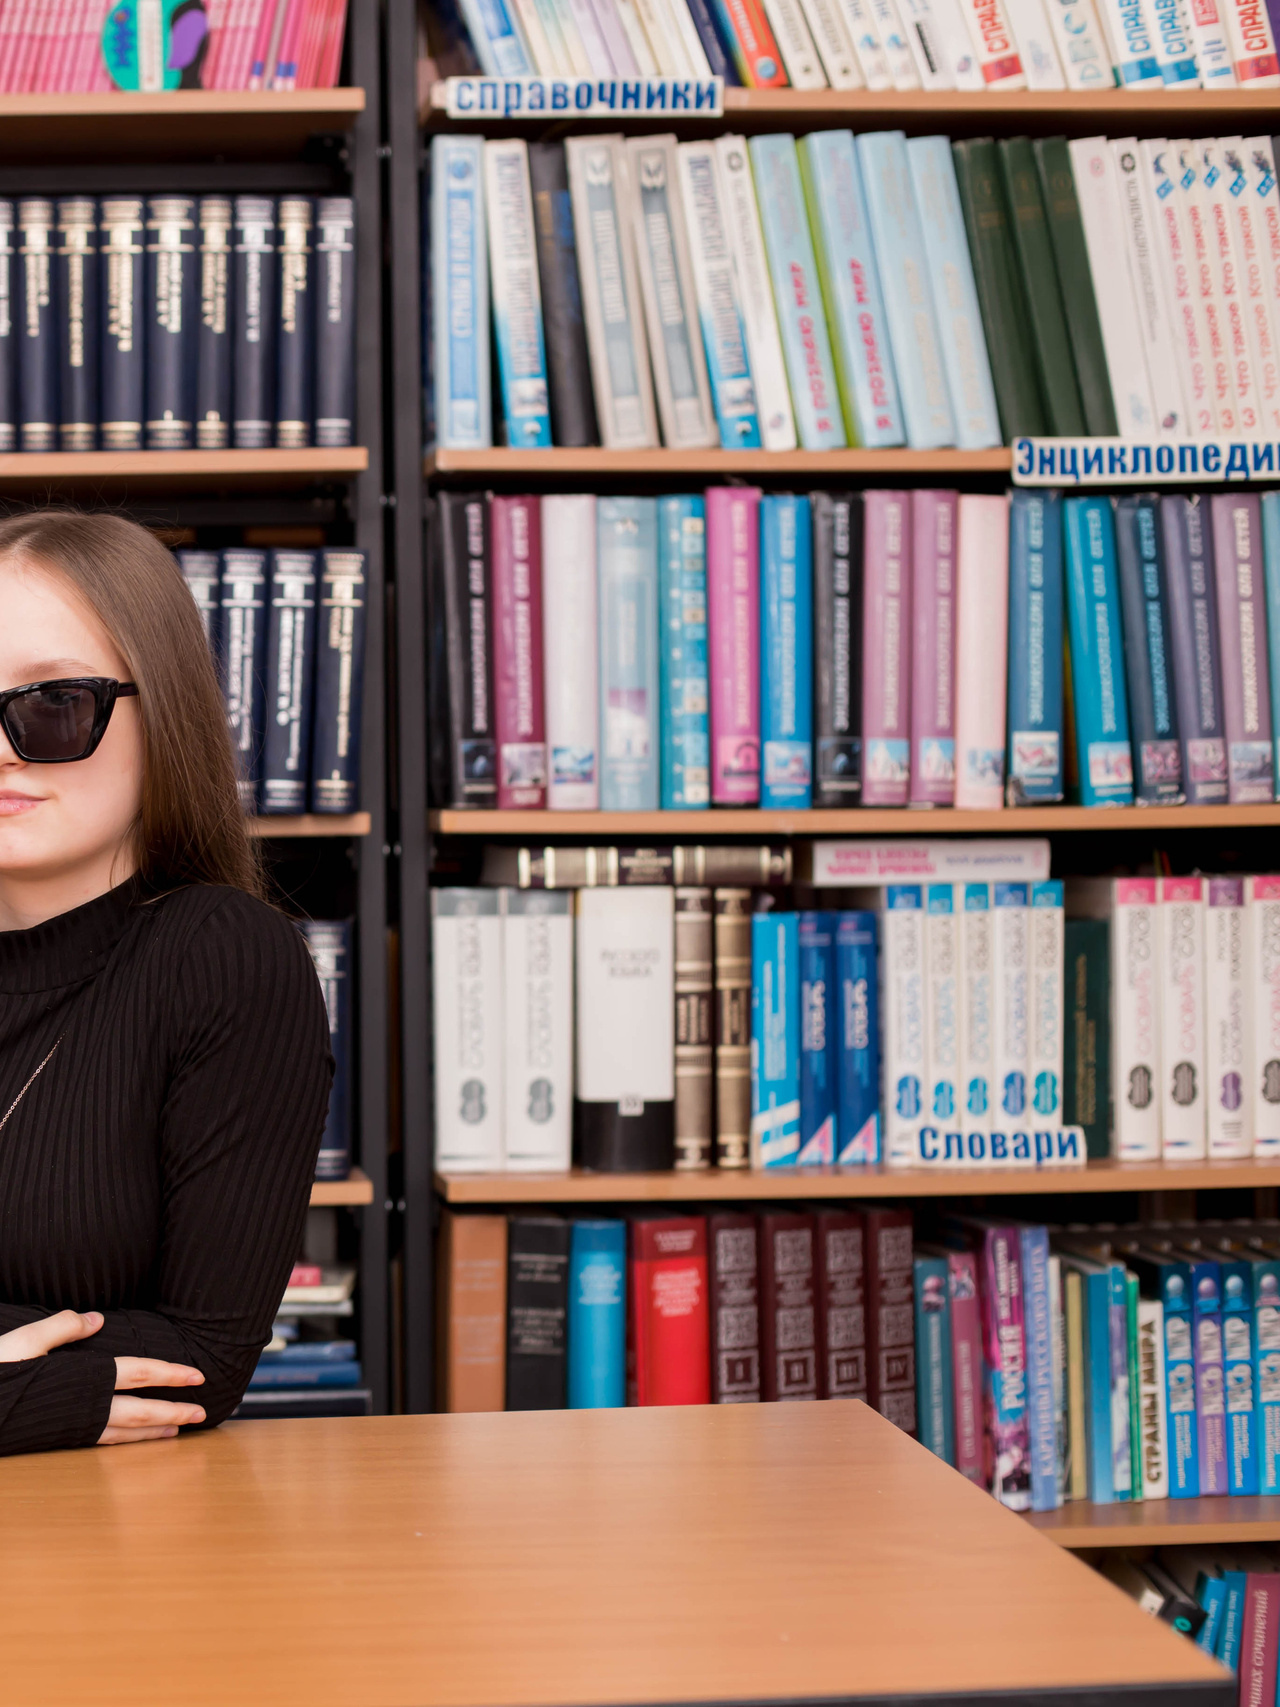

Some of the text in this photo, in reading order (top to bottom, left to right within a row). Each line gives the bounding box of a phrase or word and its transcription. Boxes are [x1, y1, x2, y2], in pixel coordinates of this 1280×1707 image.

[1220, 409, 1235, 429] 3
[1241, 408, 1256, 427] 3
[1017, 438, 1280, 481] Энциклопеди
[920, 1127, 1078, 1166] Словари
[1000, 1325, 1025, 1410] РОССИЯ
[1033, 1292, 1049, 1385] РУССКОГО
[1140, 1320, 1161, 1482] СТРАНЫ МИРА
[1251, 1588, 1269, 1666] сочинений
